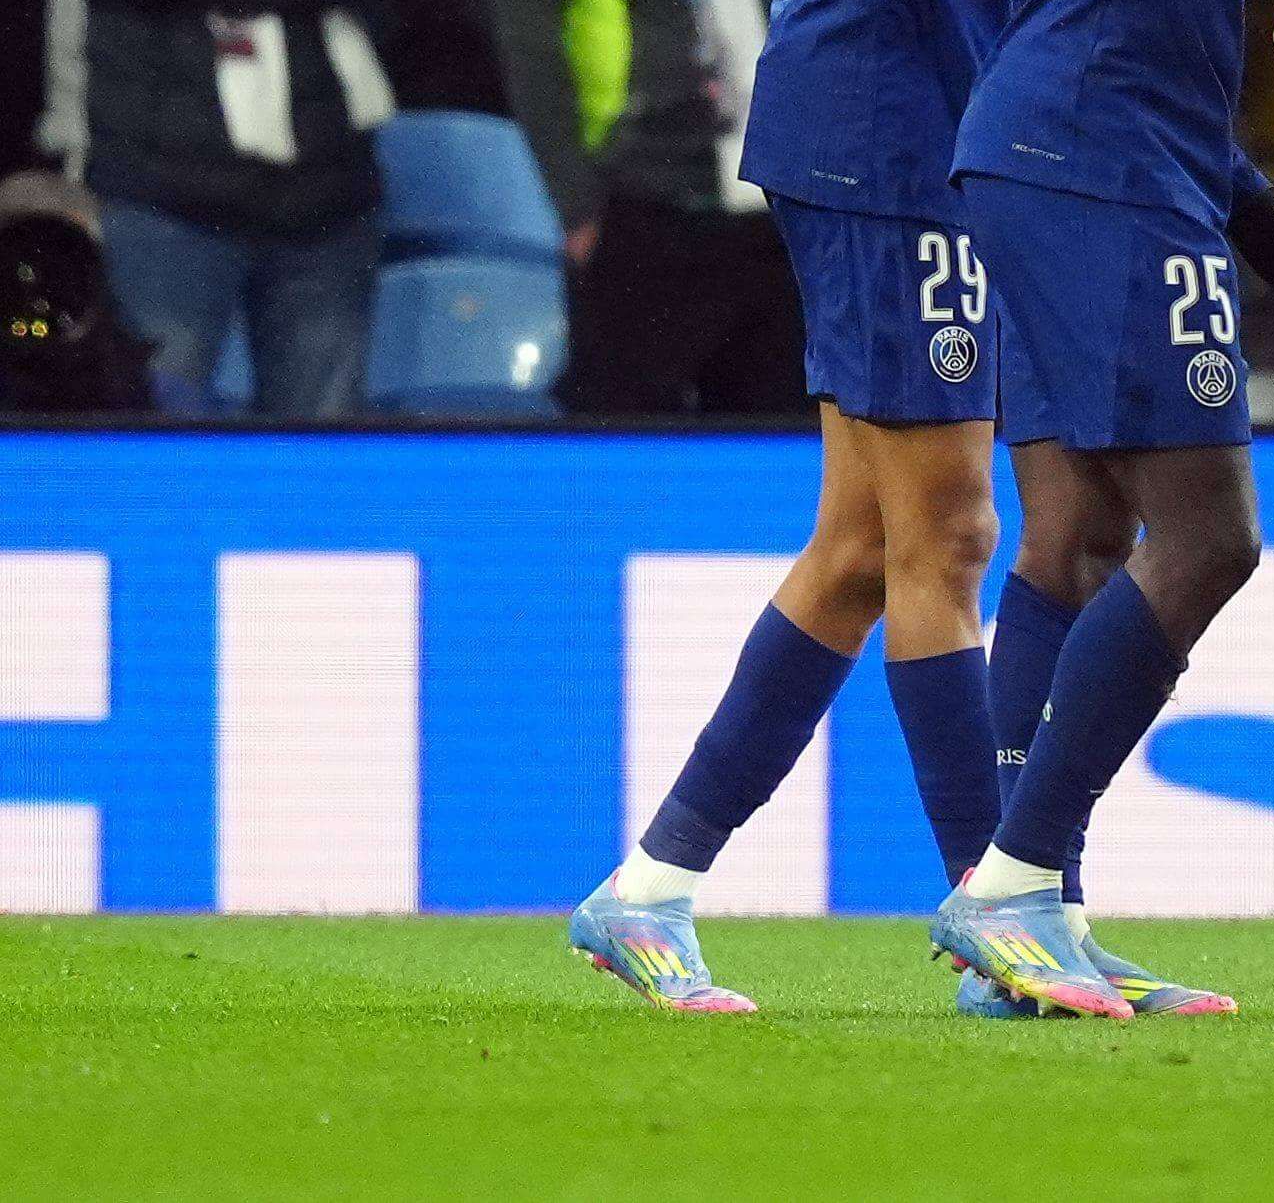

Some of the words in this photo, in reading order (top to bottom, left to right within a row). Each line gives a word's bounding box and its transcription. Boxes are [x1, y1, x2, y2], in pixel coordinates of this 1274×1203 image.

[918, 231, 987, 323] 29
[1163, 254, 1235, 345] 25
[936, 329, 971, 344] PARIS
[996, 748, 1027, 766] RIS
